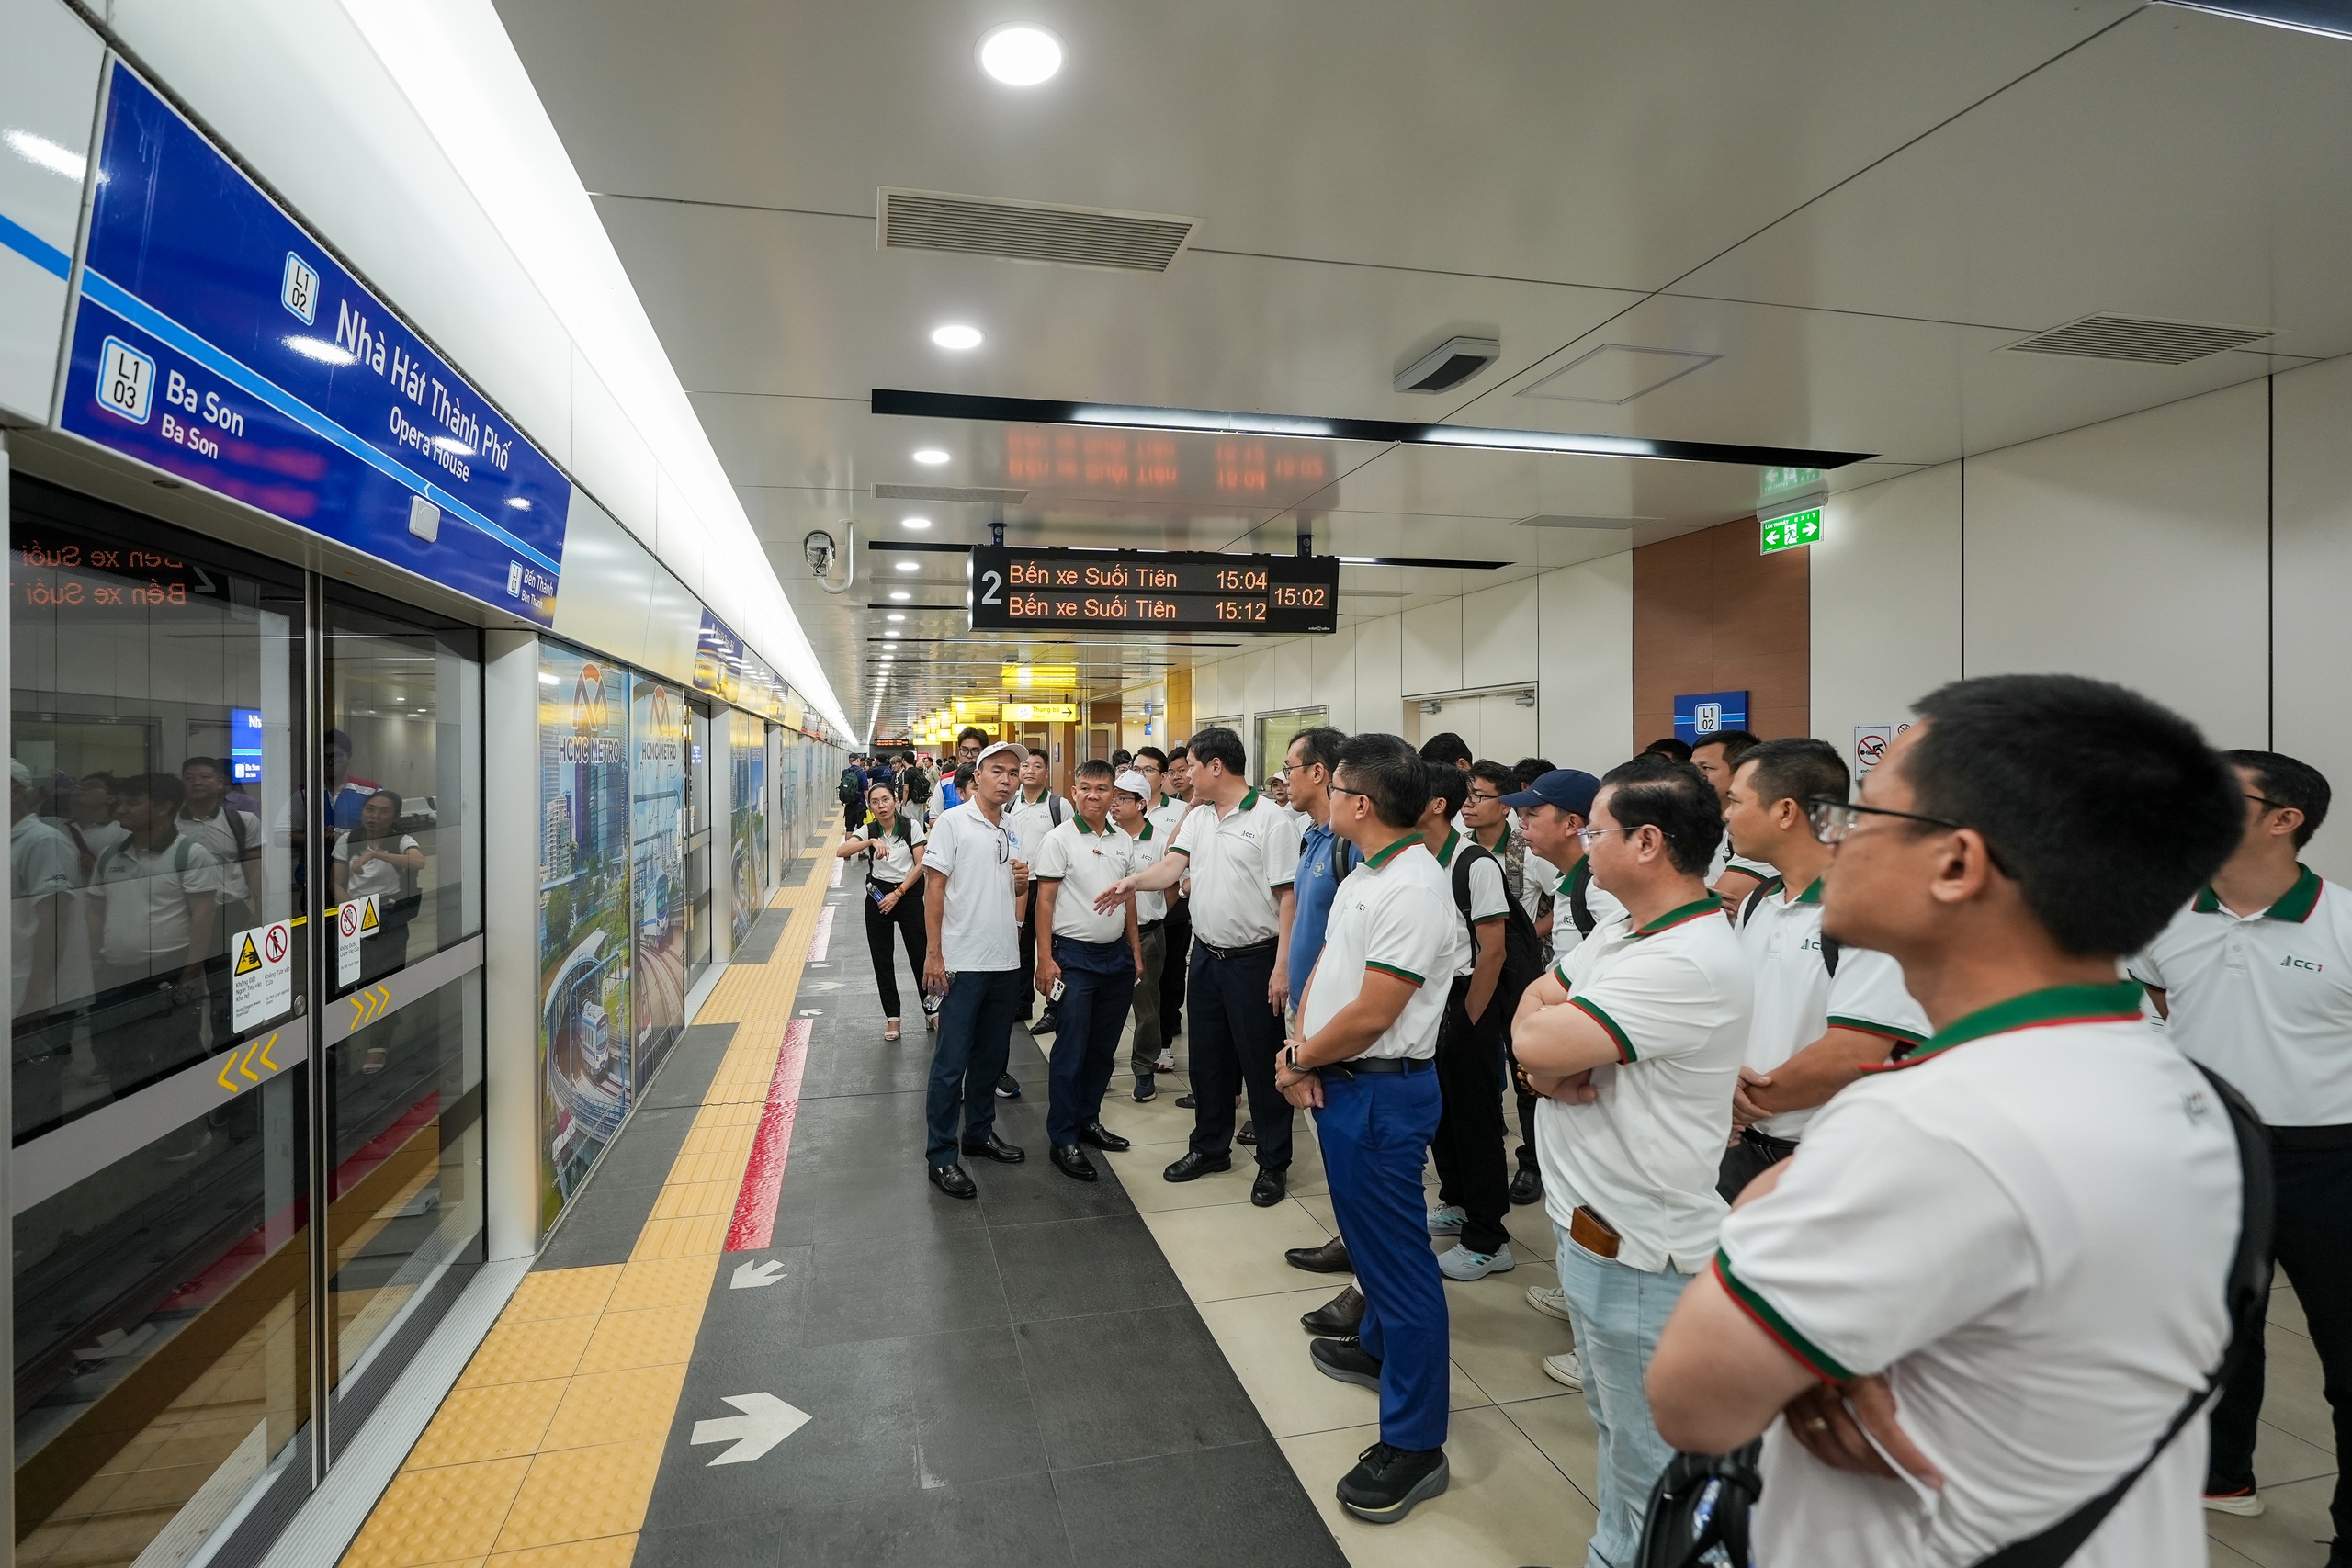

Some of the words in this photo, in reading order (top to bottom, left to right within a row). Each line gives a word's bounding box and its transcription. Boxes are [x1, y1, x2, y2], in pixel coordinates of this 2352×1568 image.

[295, 265, 310, 292] L1
[291, 287, 307, 313] 02
[118, 353, 140, 384] L1
[113, 380, 136, 409] 03
[336, 299, 387, 376] Nhà
[390, 346, 426, 406] Hát
[431, 378, 480, 448] Thành
[481, 424, 513, 471] Phố
[166, 369, 198, 413] Ba
[202, 391, 244, 437] Son
[162, 413, 185, 444] Ba
[187, 427, 219, 459] Son
[390, 405, 431, 457] Opera
[432, 443, 469, 483] House
[1793, 513, 1816, 523] EXIT
[981, 570, 1002, 605] 2
[1010, 560, 1049, 584] Bến
[1056, 570, 1079, 585] xe
[1084, 563, 1128, 587] Suối
[1136, 568, 1177, 588] Tiên
[1216, 570, 1267, 590] 15:04
[1009, 592, 1048, 616] Bến
[1056, 602, 1078, 616] xe
[1084, 595, 1128, 617] Suối
[1135, 599, 1176, 618] Tiên
[1216, 602, 1267, 620] 15:12
[1274, 588, 1325, 606] 15:02
[1702, 707, 1713, 718] L1
[1702, 719, 1713, 730] 02
[559, 735, 589, 763] HCMC
[591, 737, 620, 763] METRO
[642, 740, 659, 761] HCMC
[659, 740, 677, 761] METRO
